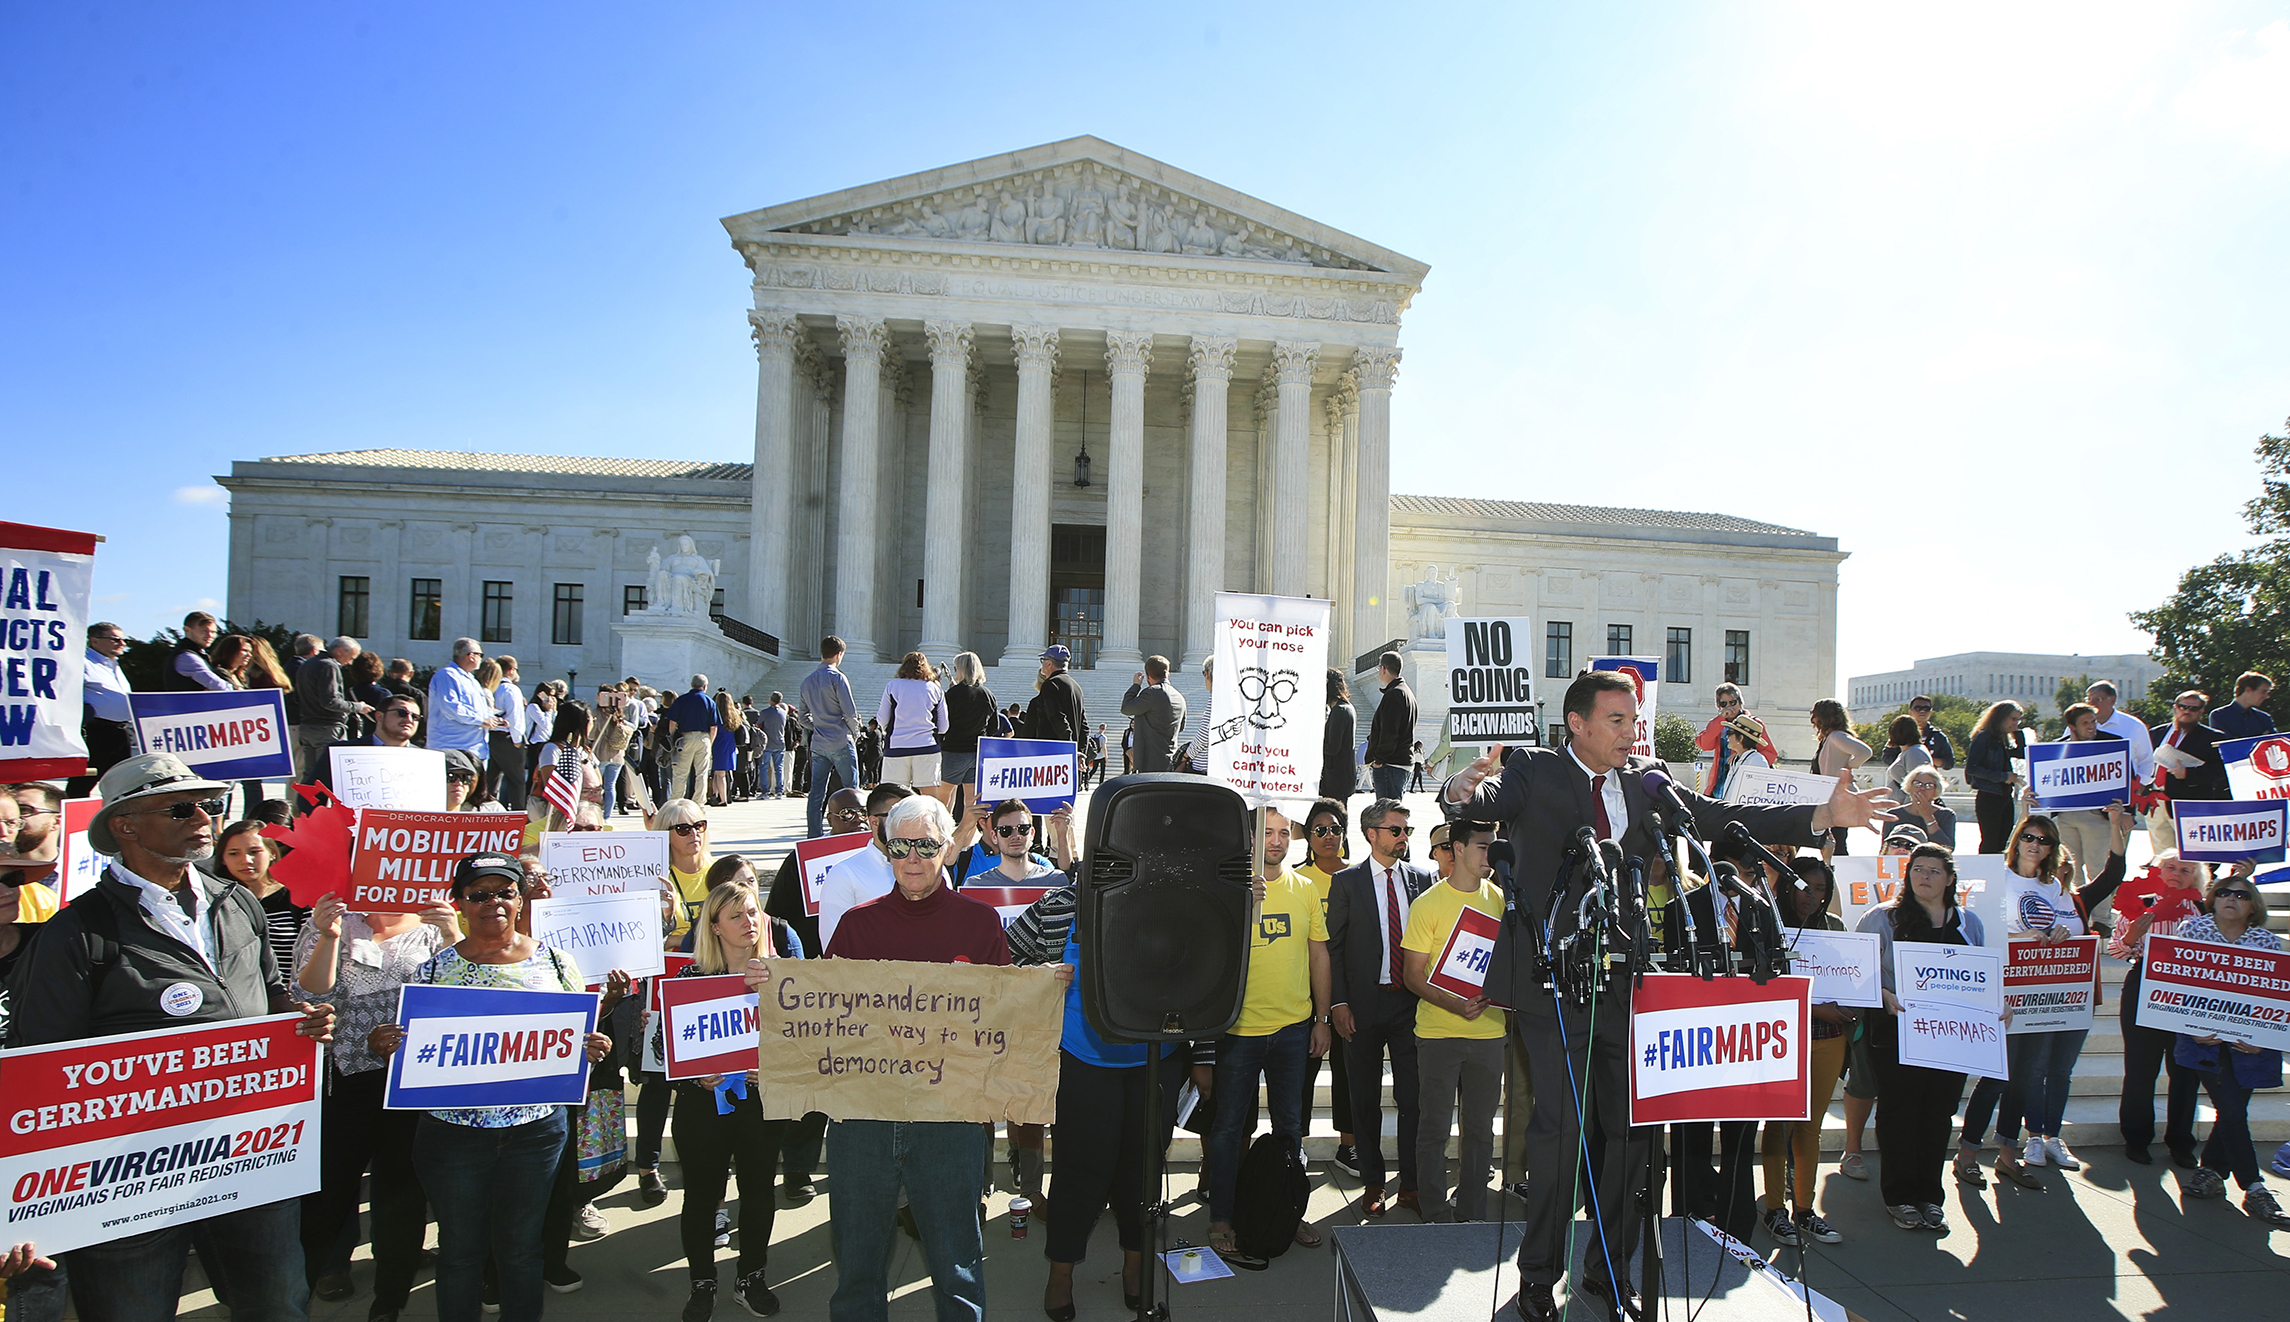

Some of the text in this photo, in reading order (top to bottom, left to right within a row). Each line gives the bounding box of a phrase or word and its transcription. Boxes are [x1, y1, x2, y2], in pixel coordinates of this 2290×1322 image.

[961, 281, 1205, 307] EQUAL JUSTICE UNDER LAW
[1229, 618, 1314, 637] you can pick
[1238, 637, 1304, 653] your nose
[1463, 620, 1513, 667] NO
[1451, 667, 1531, 704] GOING
[152, 717, 271, 753] #FAIRMAPS
[1450, 712, 1534, 736] BACKWARDS
[1241, 742, 1290, 759] but you
[346, 769, 375, 786] Fair
[989, 764, 1069, 789] #FAIRMAPS
[1232, 760, 1296, 776] can't pick
[2041, 760, 2122, 787] #FAIRMAPS
[347, 787, 373, 801] Fair
[1261, 780, 1304, 793] voters!
[1766, 782, 1798, 796] END
[389, 813, 510, 824] DEMOCRACY INITIATIVE
[2188, 819, 2277, 842] #FAIRMAPS
[363, 827, 521, 854] MOBILIZING
[582, 845, 626, 863] END
[550, 863, 662, 888] GERRYMANDERING
[354, 885, 398, 903] FOR
[540, 920, 646, 950] #FAIRMAPS
[1262, 918, 1287, 935] Us
[2017, 946, 2081, 961] YOU'VE BEEN
[2173, 947, 2277, 973] YOU'VE BEEN
[1796, 954, 1862, 982] #fairmaps
[1914, 966, 1986, 983] VOTING IS
[2003, 962, 2092, 978] GERRYMANDERED!
[777, 976, 982, 1024] Gerrymandering
[1930, 983, 1986, 993] people power
[2146, 1002, 2288, 1032] VIRGINIANS FOR FAIR REDISTRICTING
[782, 1017, 1007, 1055] another way to rig
[1913, 1018, 1997, 1043] #FAIRMAPS
[416, 1028, 575, 1068] #FAIRMAPS
[1643, 1020, 1788, 1071] #FAIRMAPS
[62, 1037, 271, 1089] YOU'VE BEEN
[817, 1046, 945, 1085] democracy
[9, 1064, 307, 1136] GERRYMANDERED!
[11, 1119, 306, 1204] ONEVIRGINIA2021
[8, 1148, 298, 1224] VIRGINIANS FOR FAIR REDISTRICTING
[101, 1190, 239, 1230] www.onevirginia2021.org
